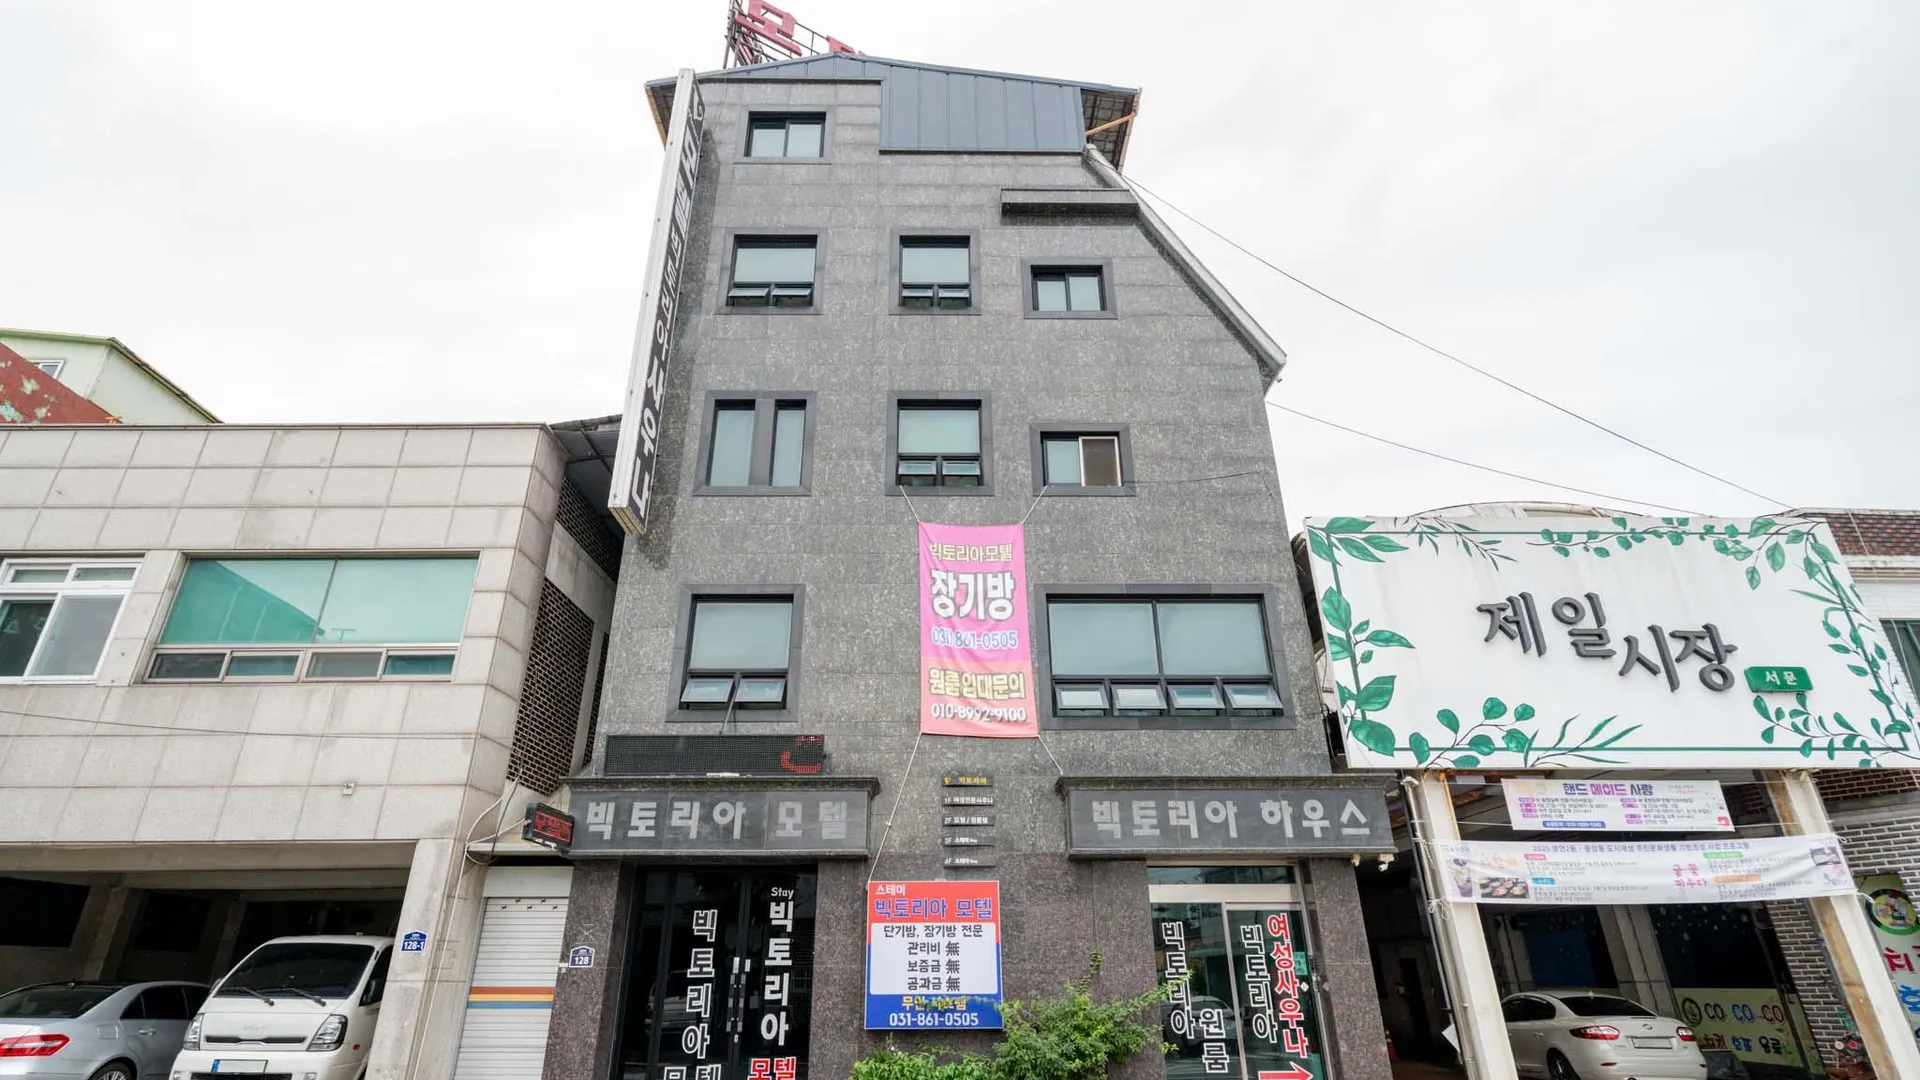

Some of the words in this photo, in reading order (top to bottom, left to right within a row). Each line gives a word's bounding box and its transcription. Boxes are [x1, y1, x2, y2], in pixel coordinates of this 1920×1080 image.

[632, 355, 665, 518] 사우나
[930, 569, 1015, 621] 장기방
[1764, 667, 1799, 687] 서문
[586, 801, 746, 840] 빅토리아
[775, 801, 848, 840] 모텔
[1091, 799, 1238, 839] 빅토리아
[1260, 798, 1371, 839] 하우스
[771, 887, 794, 900] Stay
[875, 884, 906, 896] 스테이
[875, 898, 947, 919] 빅토리아
[955, 898, 992, 919] 모텔
[924, 924, 957, 938] 장기방
[961, 924, 983, 938] 전문
[403, 940, 425, 951] 128-1
[907, 942, 941, 955] 관리비
[574, 956, 590, 966] 128
[907, 959, 941, 973] 보증금
[761, 901, 794, 1046] 빅토리아
[907, 976, 942, 991] 공과금
[682, 909, 718, 1060] 빅토리아
[1240, 925, 1278, 1044] 빅토리아
[1267, 913, 1309, 1059] 여성사우나
[889, 1012, 979, 1027] 031-861-0505
[1200, 1008, 1230, 1074] 원룸
[746, 1056, 797, 1080] 모텔
